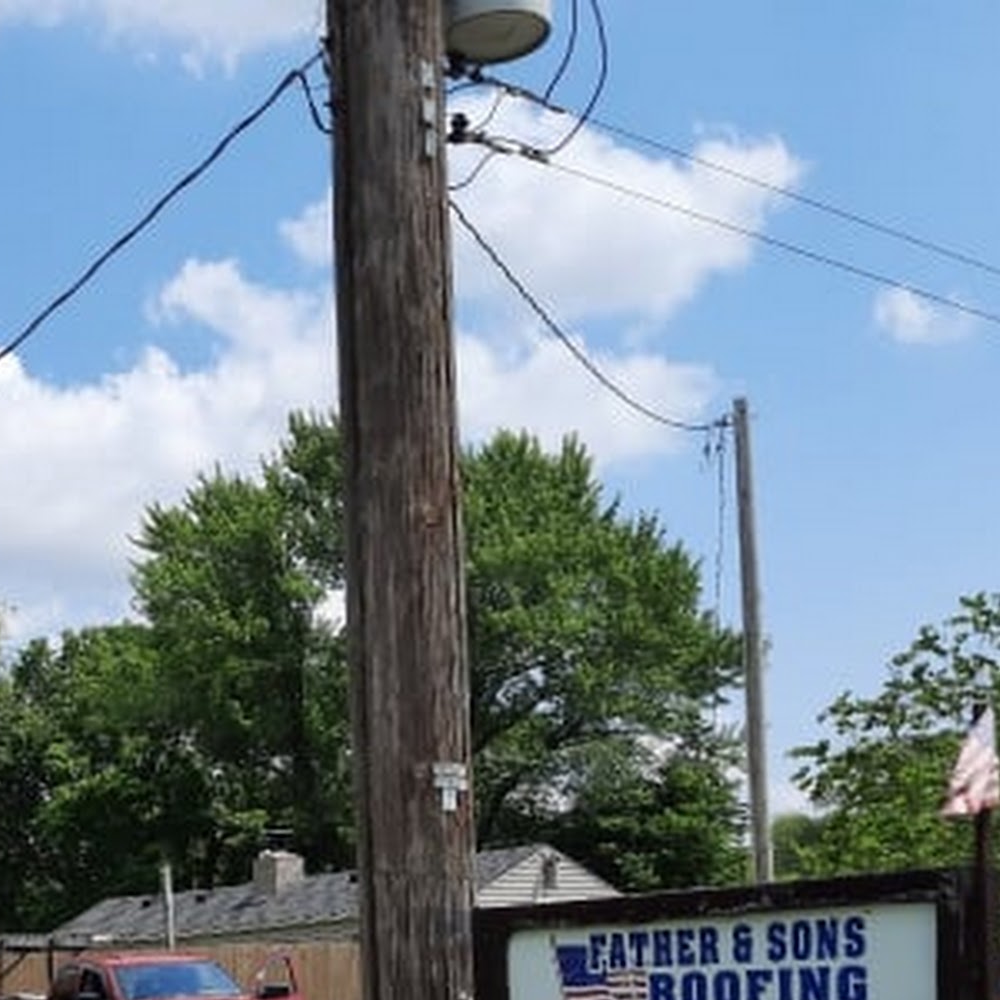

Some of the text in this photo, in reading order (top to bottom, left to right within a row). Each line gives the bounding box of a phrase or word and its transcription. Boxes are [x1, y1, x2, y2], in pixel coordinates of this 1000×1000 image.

[588, 916, 867, 970] FATHER & SONS
